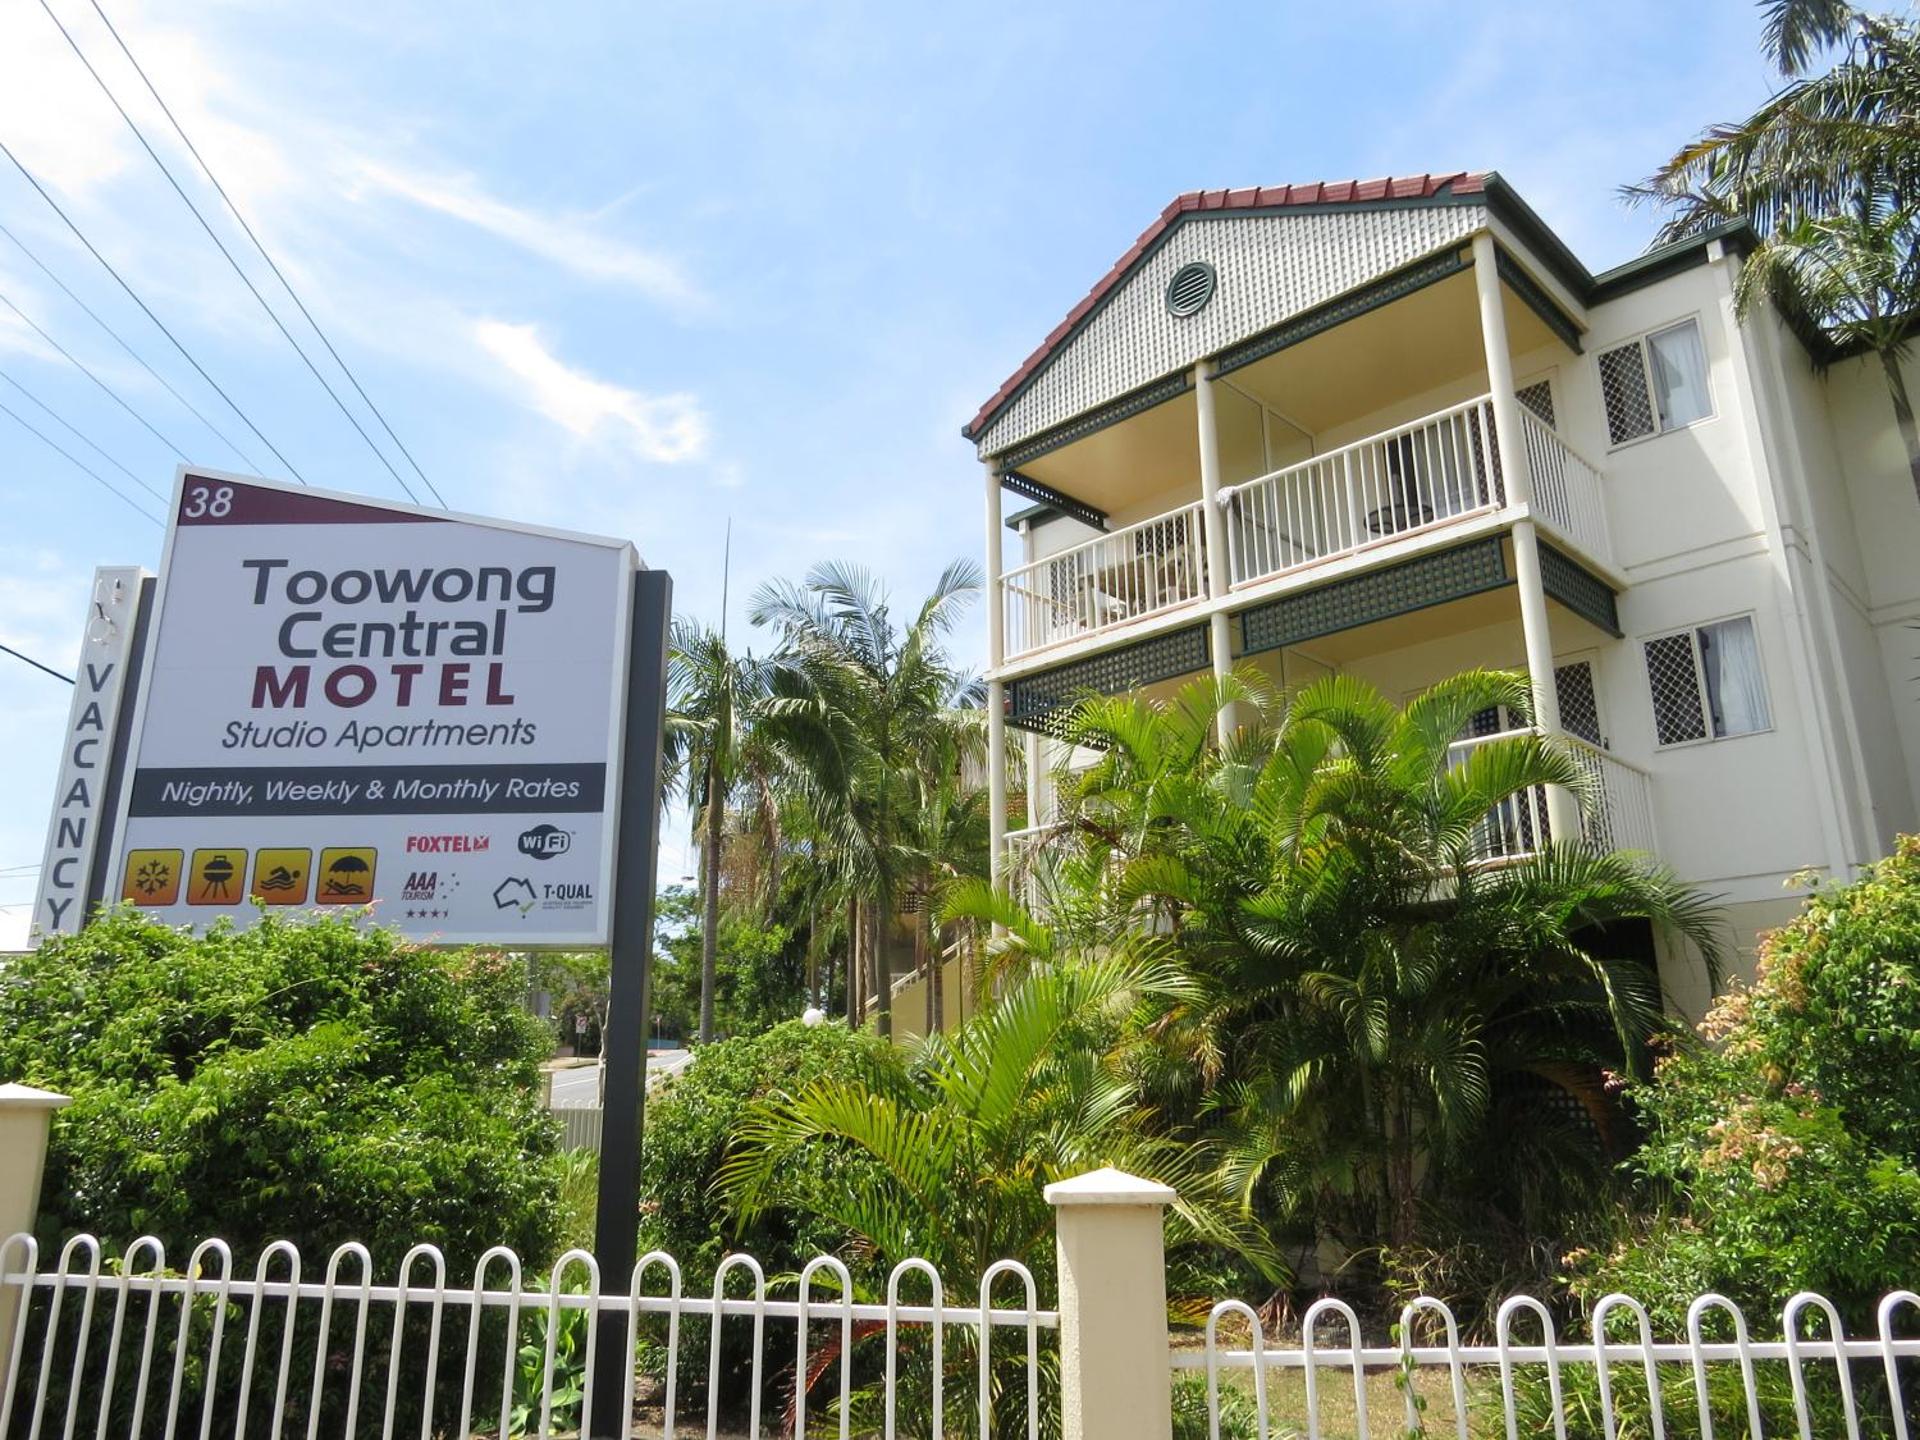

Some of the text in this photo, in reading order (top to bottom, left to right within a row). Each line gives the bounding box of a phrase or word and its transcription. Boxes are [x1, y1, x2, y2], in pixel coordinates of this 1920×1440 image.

[185, 487, 234, 518] 38
[242, 559, 556, 613] Toowong
[278, 609, 507, 659] Central
[251, 663, 515, 709] MOTEL
[222, 717, 537, 753] Studio Apartments
[46, 663, 115, 930] VACANCY
[161, 777, 581, 807] Nightly, Weekly & Monthly Rates
[406, 836, 472, 854] FOXTEL
[404, 871, 438, 890] AAA
